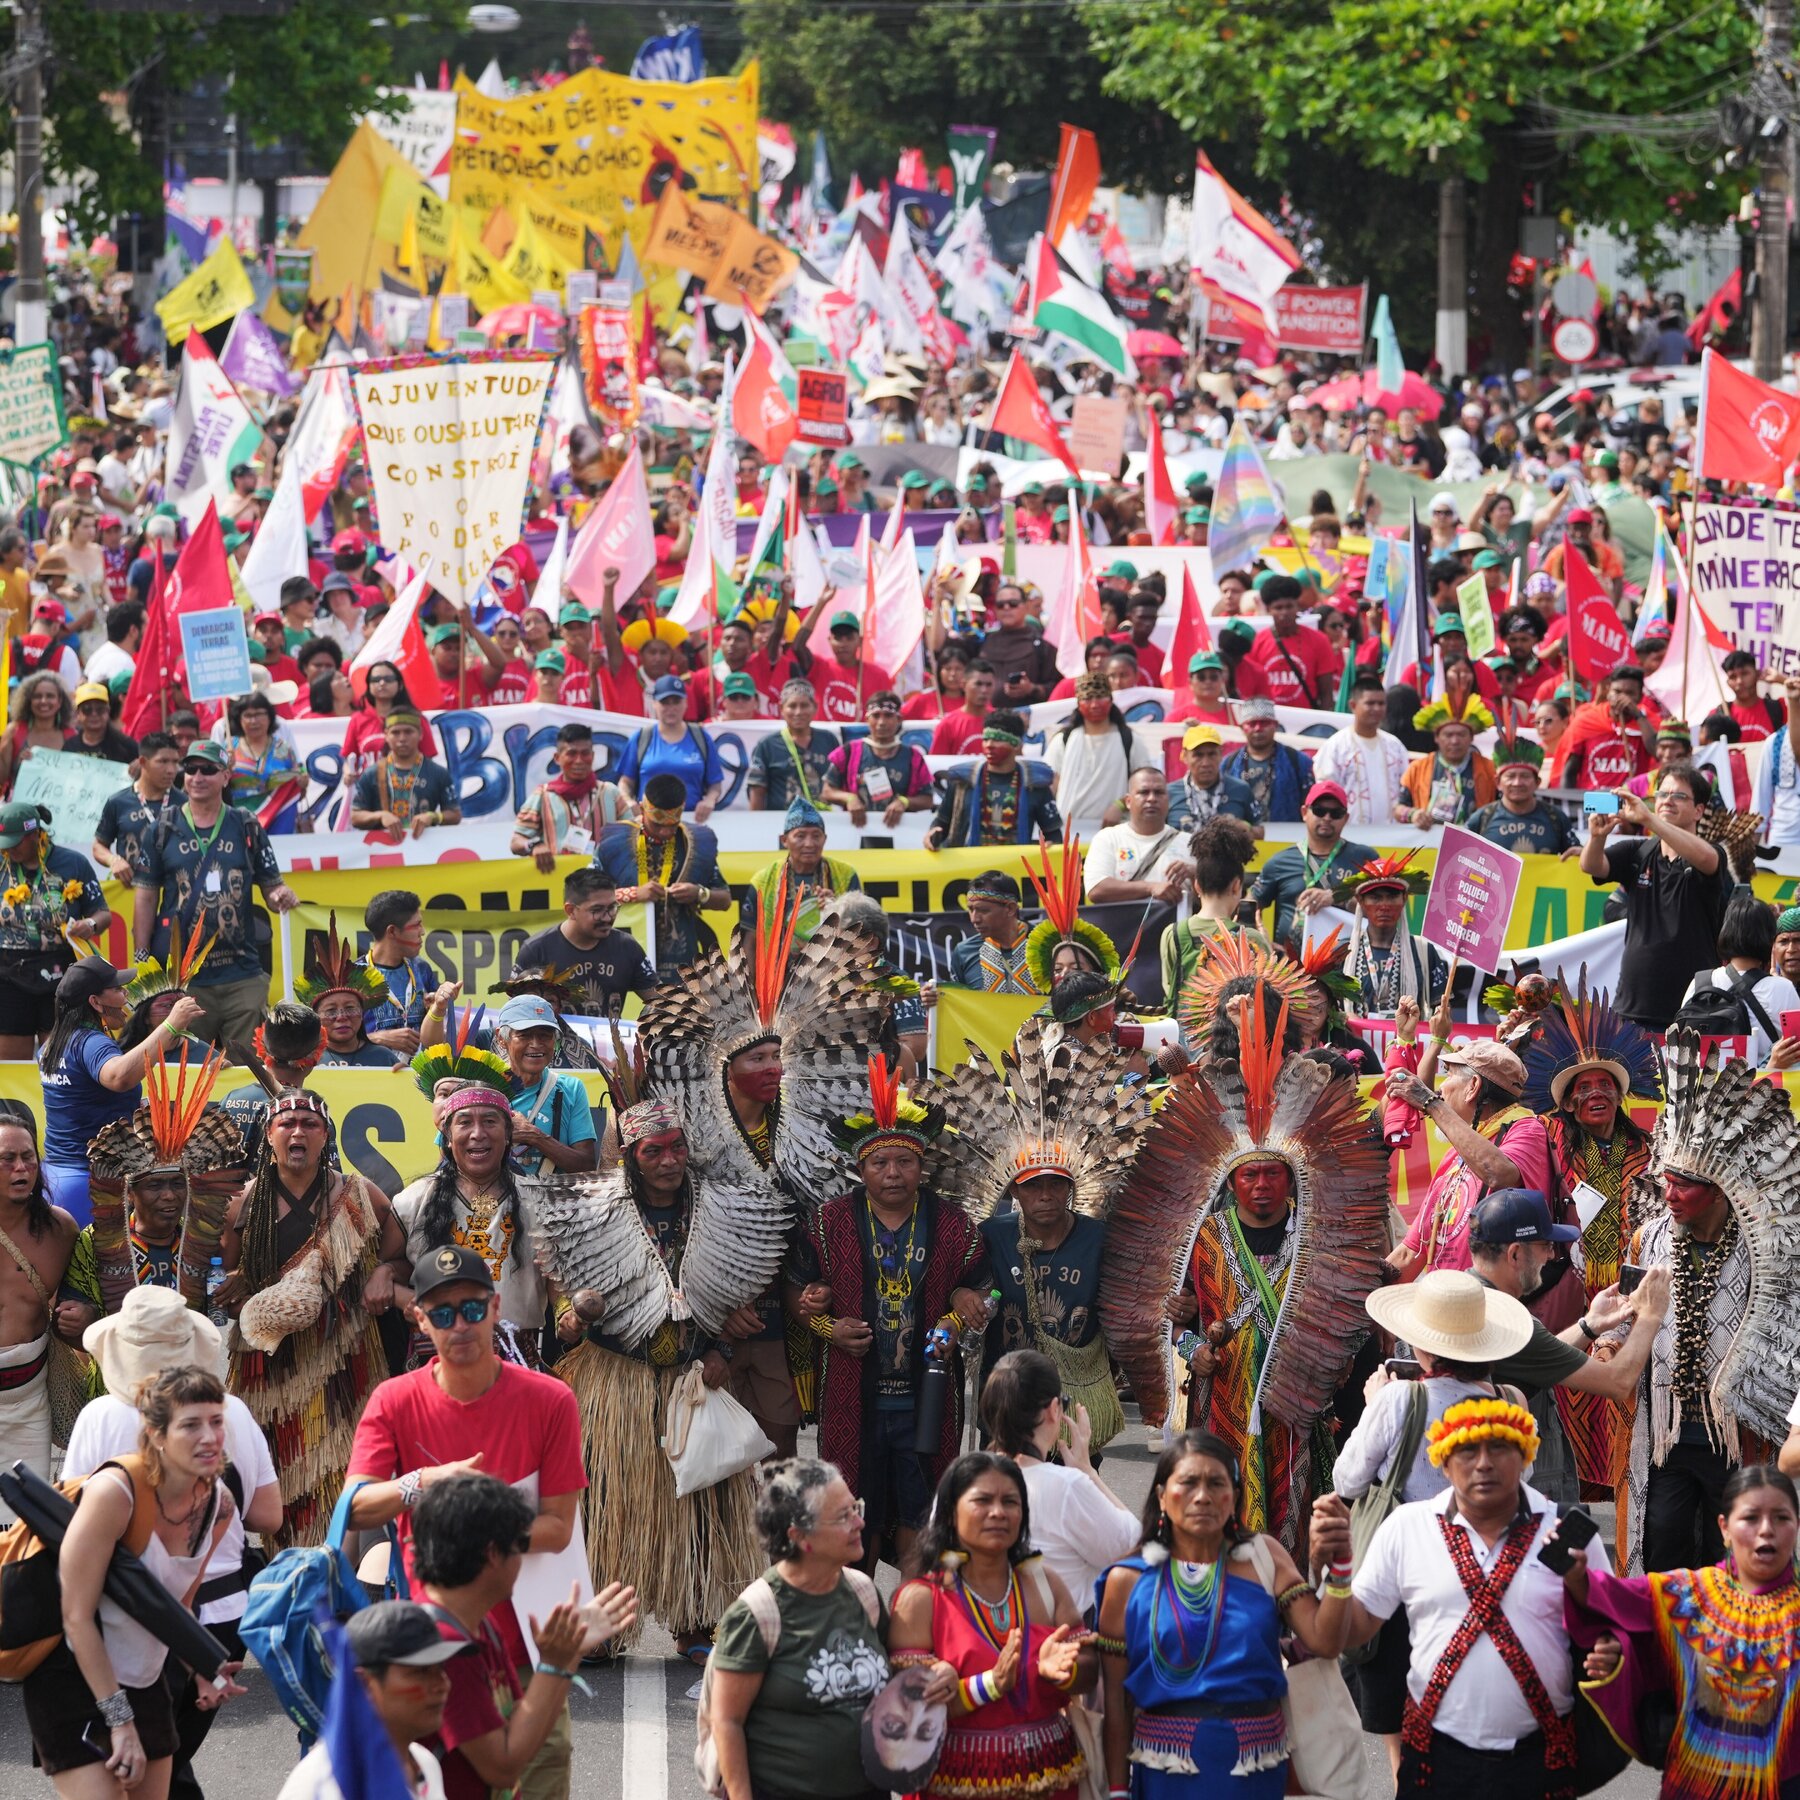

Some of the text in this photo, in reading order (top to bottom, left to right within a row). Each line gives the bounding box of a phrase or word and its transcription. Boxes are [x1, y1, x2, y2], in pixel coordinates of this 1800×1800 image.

[1278, 313, 1358, 334] ANSITION
[801, 379, 844, 404] AGRO
[367, 422, 406, 445] QUE
[456, 498, 468, 516] O
[1692, 509, 1765, 545] ONDE
[1581, 612, 1625, 652] MAM
[1499, 822, 1546, 837] COP 30
[216, 839, 235, 854] 30
[1336, 867, 1353, 880] 30
[1458, 879, 1490, 903] POLUEM
[598, 962, 615, 977] 30
[225, 1099, 262, 1111] BASTA DE
[1451, 1206, 1472, 1238] NETWORK
[150, 1261, 169, 1279] OP
[1058, 1264, 1082, 1285] 30
